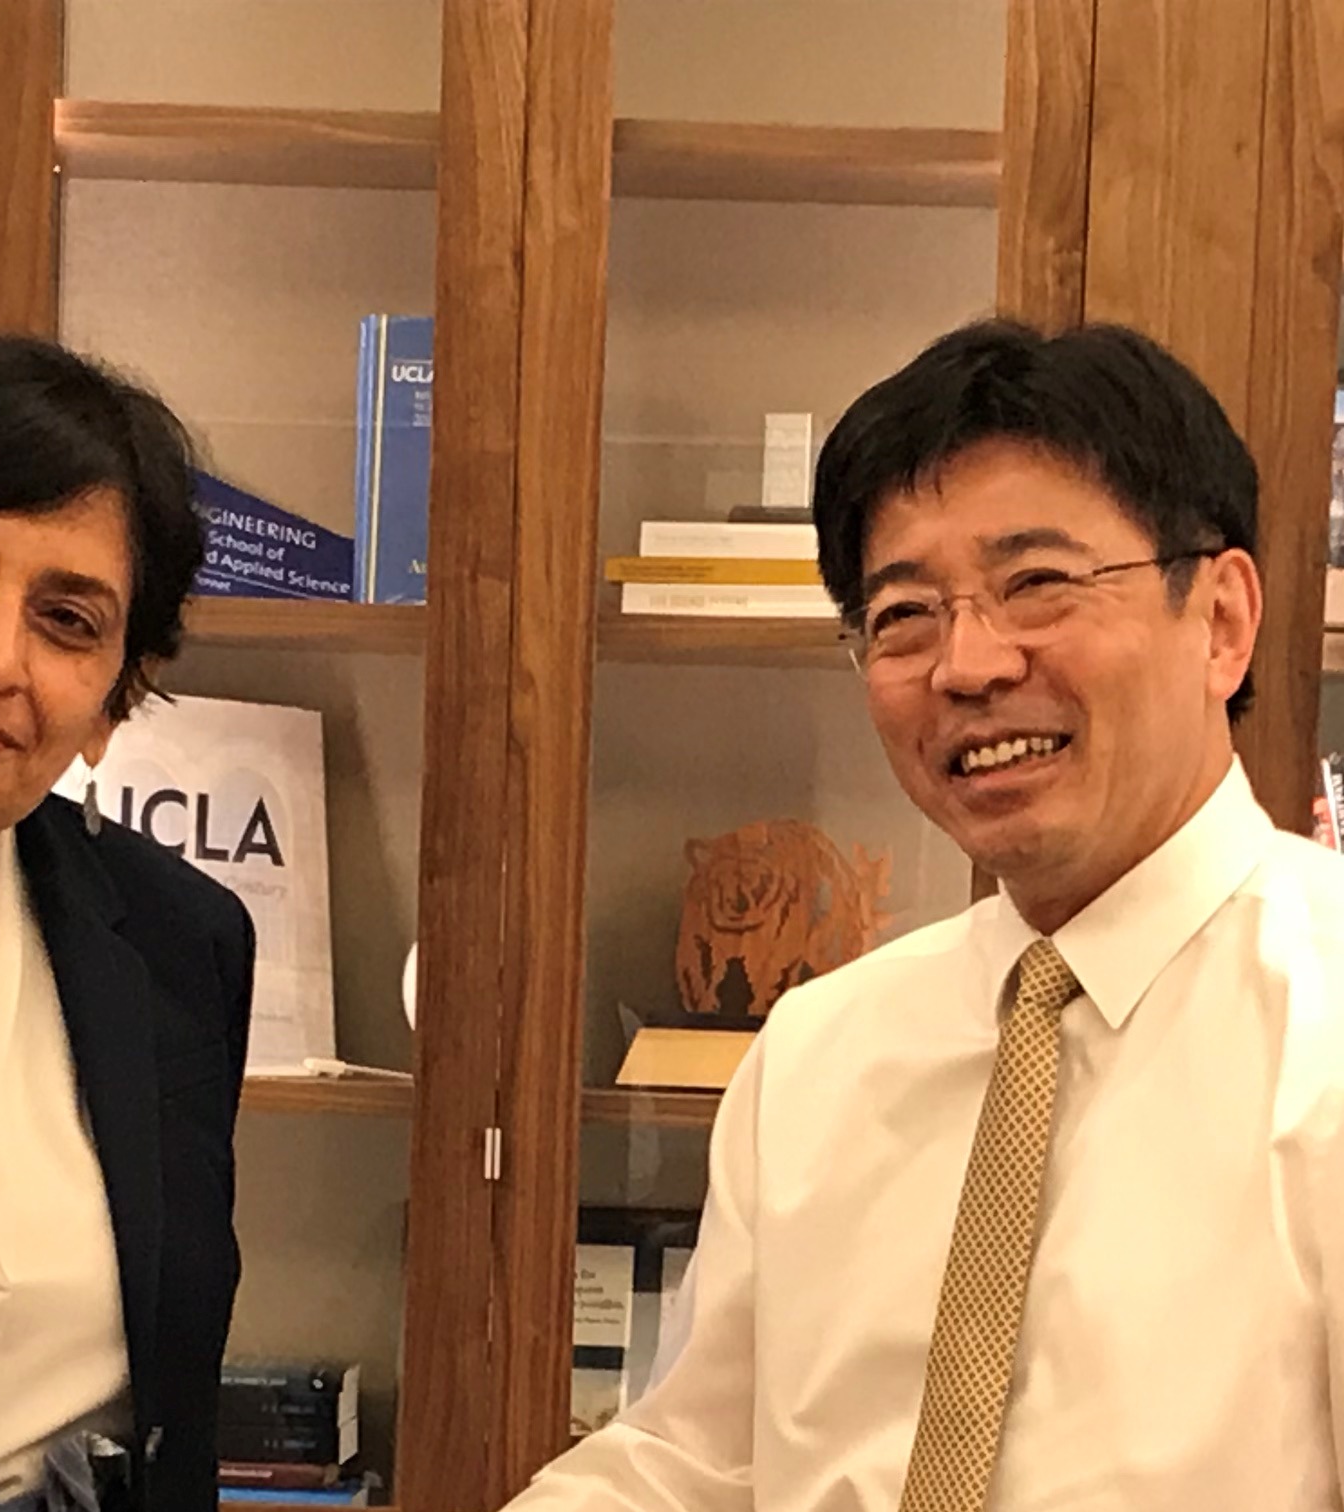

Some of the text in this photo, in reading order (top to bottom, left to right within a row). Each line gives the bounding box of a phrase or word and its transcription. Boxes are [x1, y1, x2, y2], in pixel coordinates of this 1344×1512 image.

[208, 529, 286, 562] School of
[220, 554, 284, 581] Applied
[287, 570, 351, 594] Science
